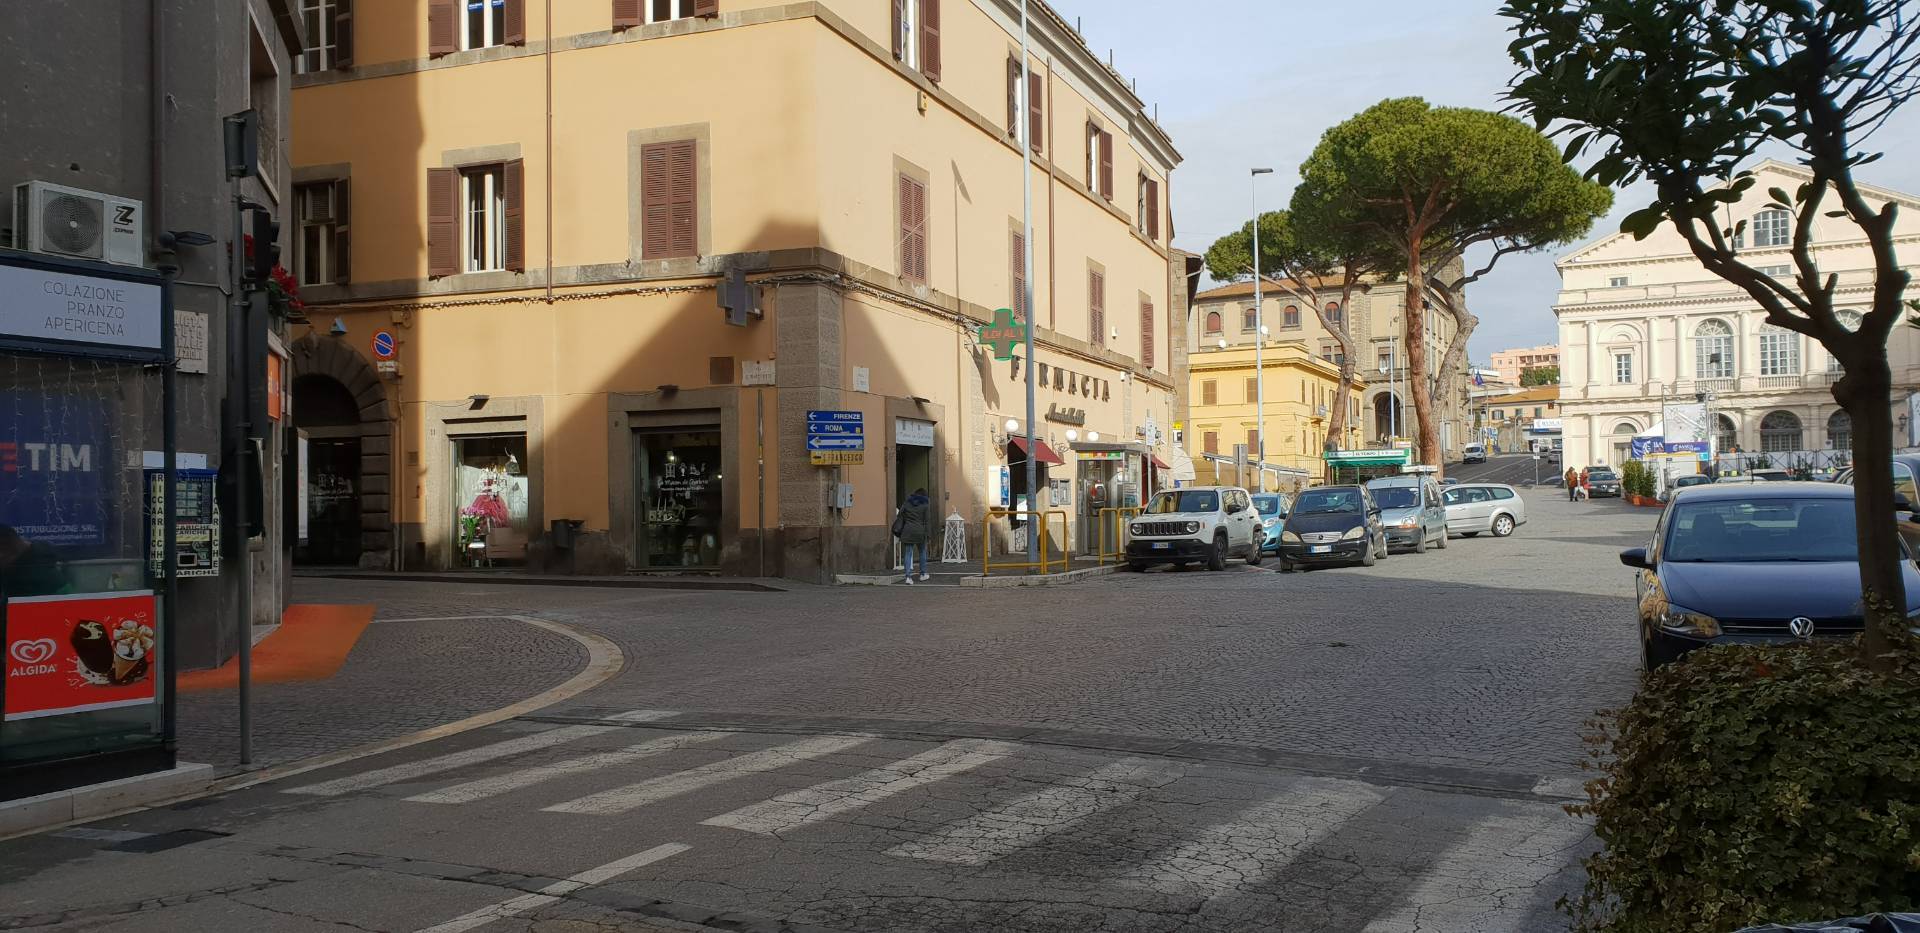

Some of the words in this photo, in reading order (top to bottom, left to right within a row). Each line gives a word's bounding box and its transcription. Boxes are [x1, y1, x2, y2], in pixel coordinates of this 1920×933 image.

[43, 280, 125, 303] COLAZIONE
[67, 300, 125, 319] PRANZO
[44, 316, 125, 336] APERICENA
[1011, 355, 1110, 402] FRMACIA
[824, 424, 843, 432] ROMA
[24, 443, 91, 472] TIM
[10, 664, 57, 677] ALGIDA
